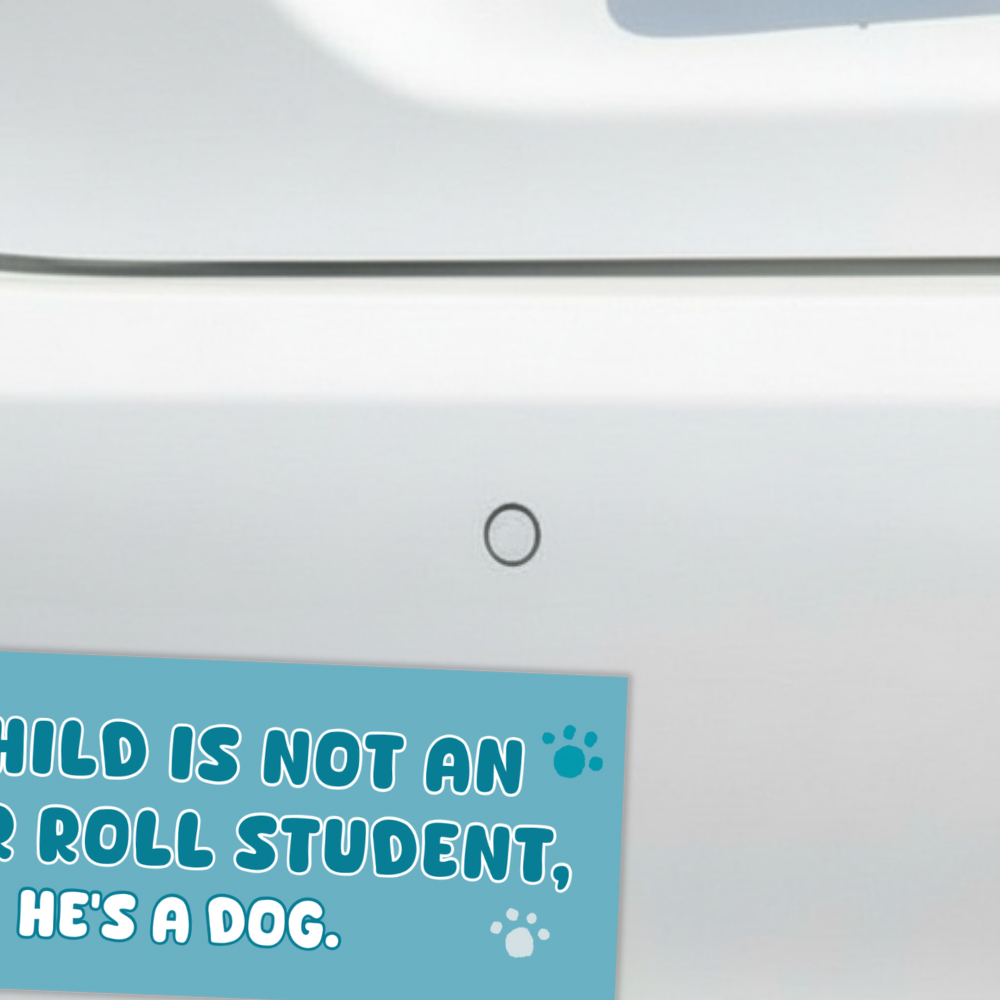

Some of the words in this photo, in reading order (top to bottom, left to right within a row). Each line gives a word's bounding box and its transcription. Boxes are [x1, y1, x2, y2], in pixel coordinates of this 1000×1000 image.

[167, 722, 243, 786] IS
[260, 726, 408, 793] NOT
[422, 733, 526, 798] AN
[35, 803, 217, 872] ROLL
[233, 811, 573, 894] STUDENT,
[15, 886, 140, 943] HE'S
[149, 892, 193, 946] A
[204, 893, 342, 952] DOG.
